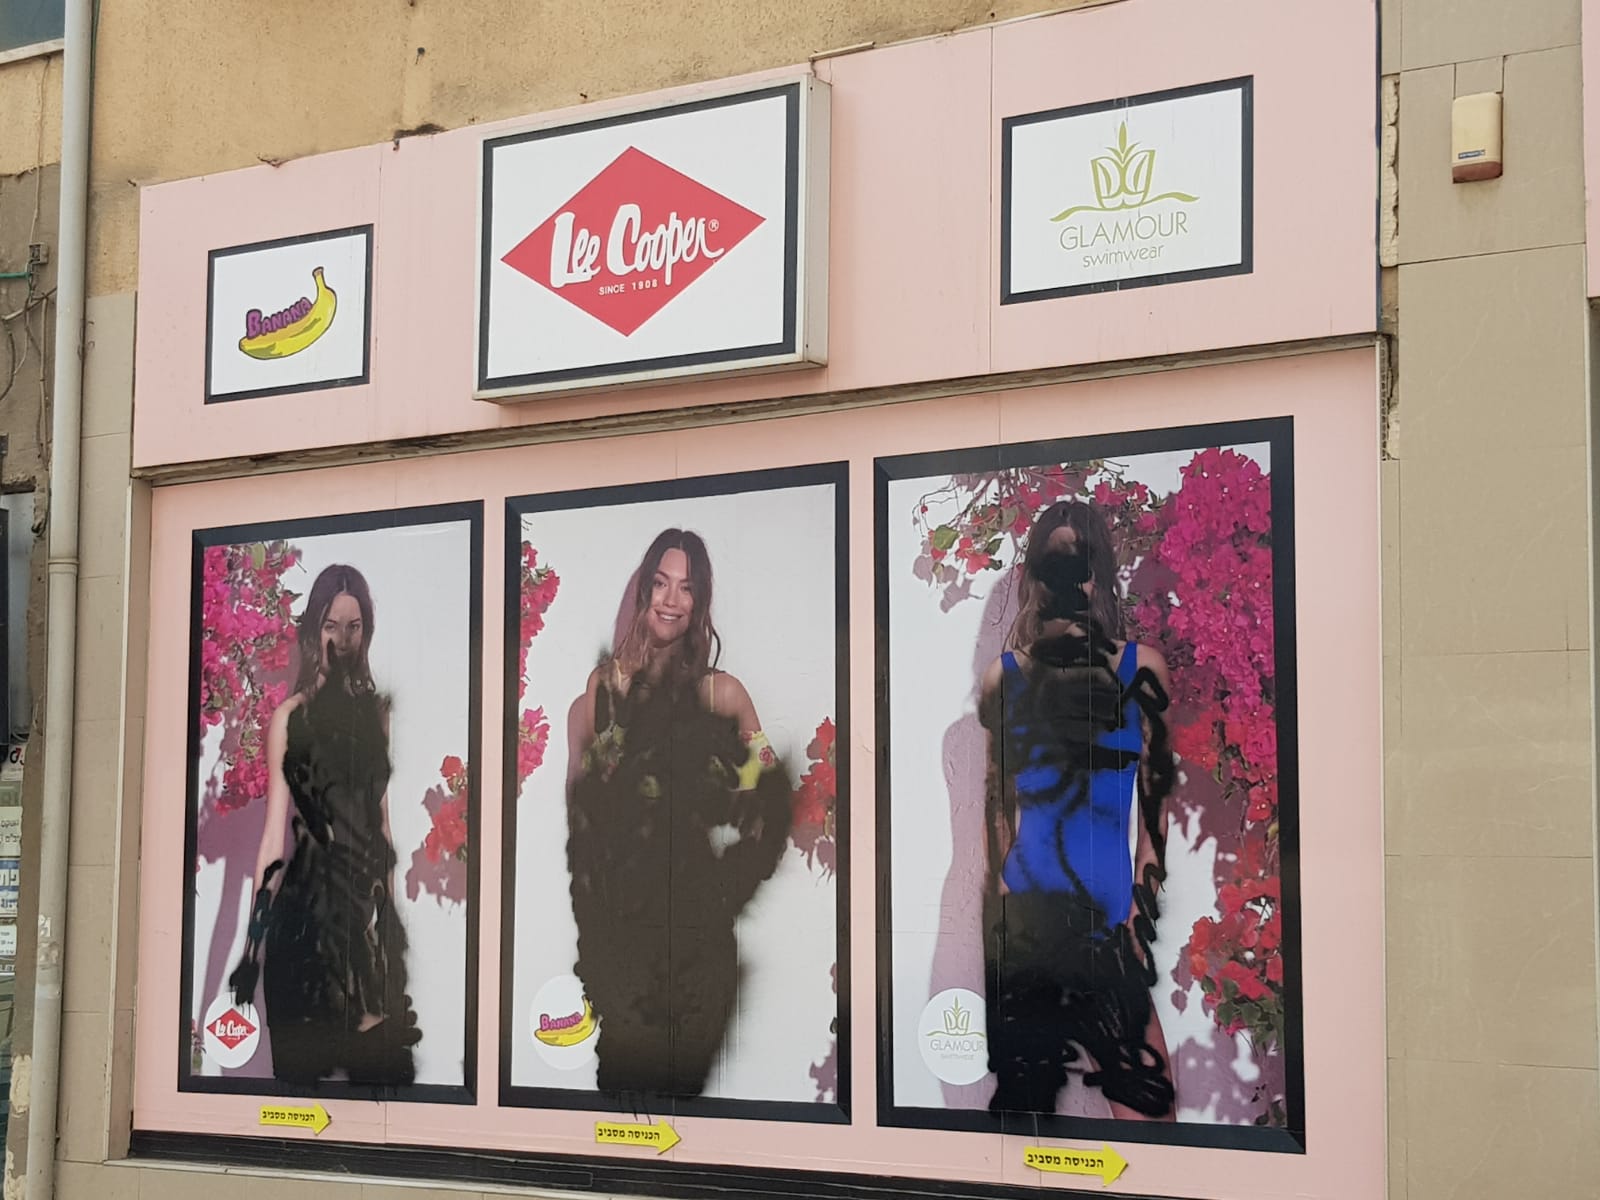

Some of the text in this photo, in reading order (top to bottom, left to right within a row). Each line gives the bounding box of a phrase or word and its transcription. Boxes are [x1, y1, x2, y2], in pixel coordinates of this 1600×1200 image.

[1060, 211, 1188, 250] GLAMOUR
[550, 212, 600, 288] Lee
[1083, 245, 1164, 268] swimwear
[598, 284, 625, 296] SINCE
[246, 296, 313, 340] BANANA
[930, 1039, 985, 1051] GLAMOUR
[262, 1110, 315, 1121] הכניסה מסביב
[598, 1127, 660, 1140] הכניסה מסביב
[1027, 1153, 1104, 1169] הכניסה מסביב
